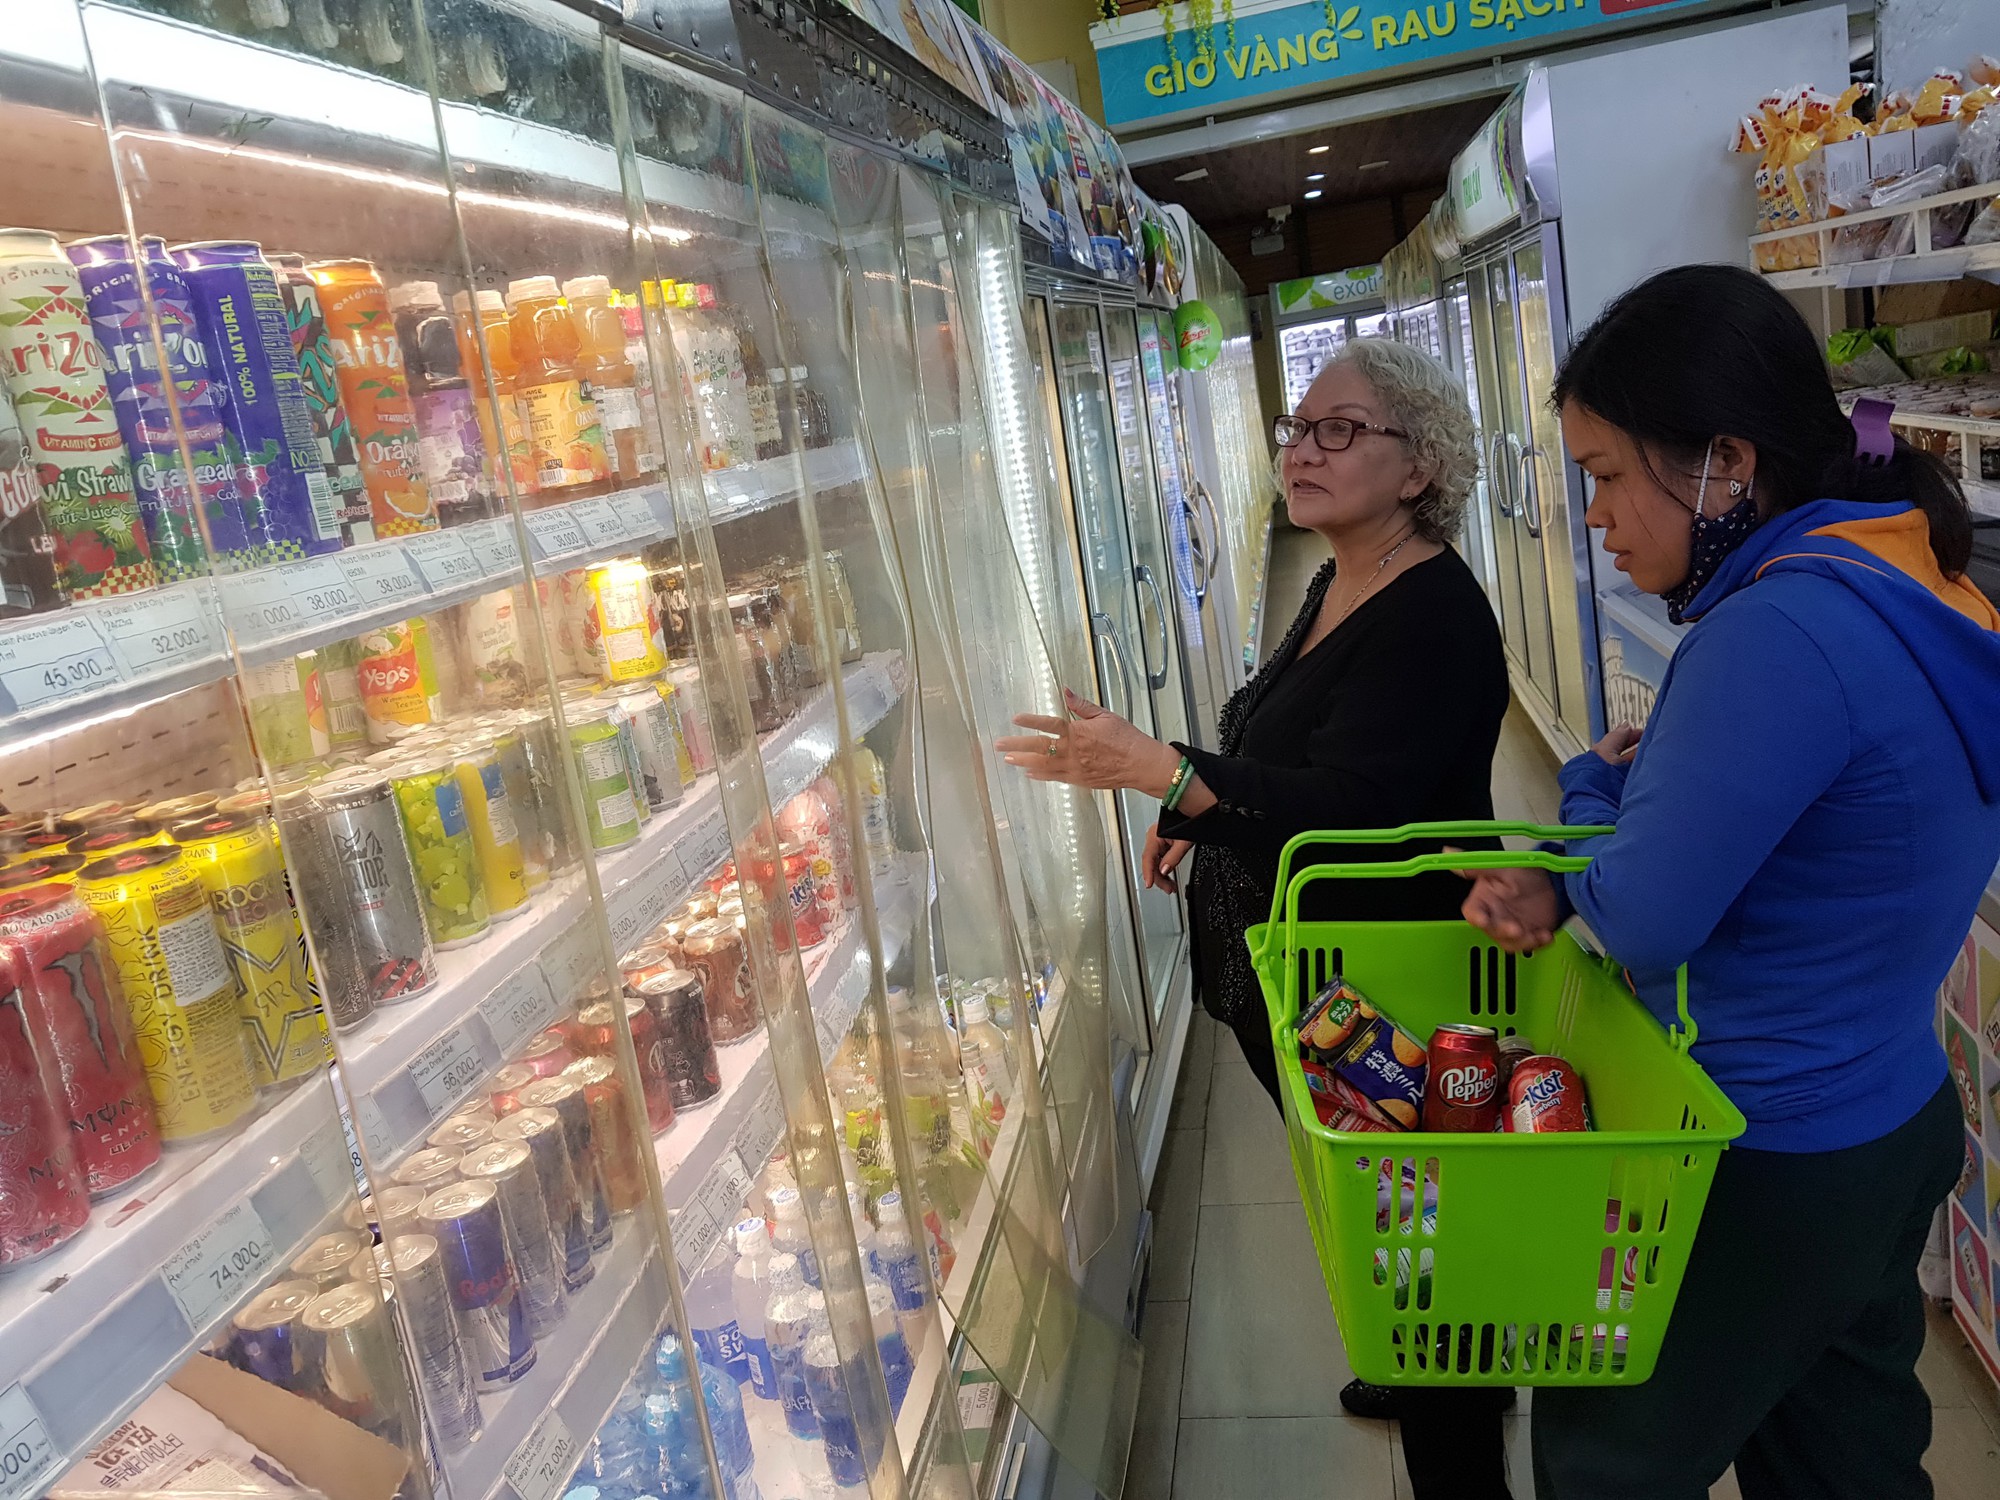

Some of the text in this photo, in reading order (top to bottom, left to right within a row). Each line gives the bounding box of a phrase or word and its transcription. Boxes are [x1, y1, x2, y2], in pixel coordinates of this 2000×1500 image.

[1223, 28, 1340, 79] VÀNG
[1371, 0, 1457, 50] RAU
[85, 272, 160, 302] ORIGINL
[218, 294, 249, 365] NATURAL
[44, 436, 87, 450] VITAMIN
[136, 924, 174, 1001] DRINK
[1443, 1068, 1498, 1101] Pepper
[1464, 1065, 1487, 1084] Dr
[93, 1424, 159, 1470] ICE TEA
